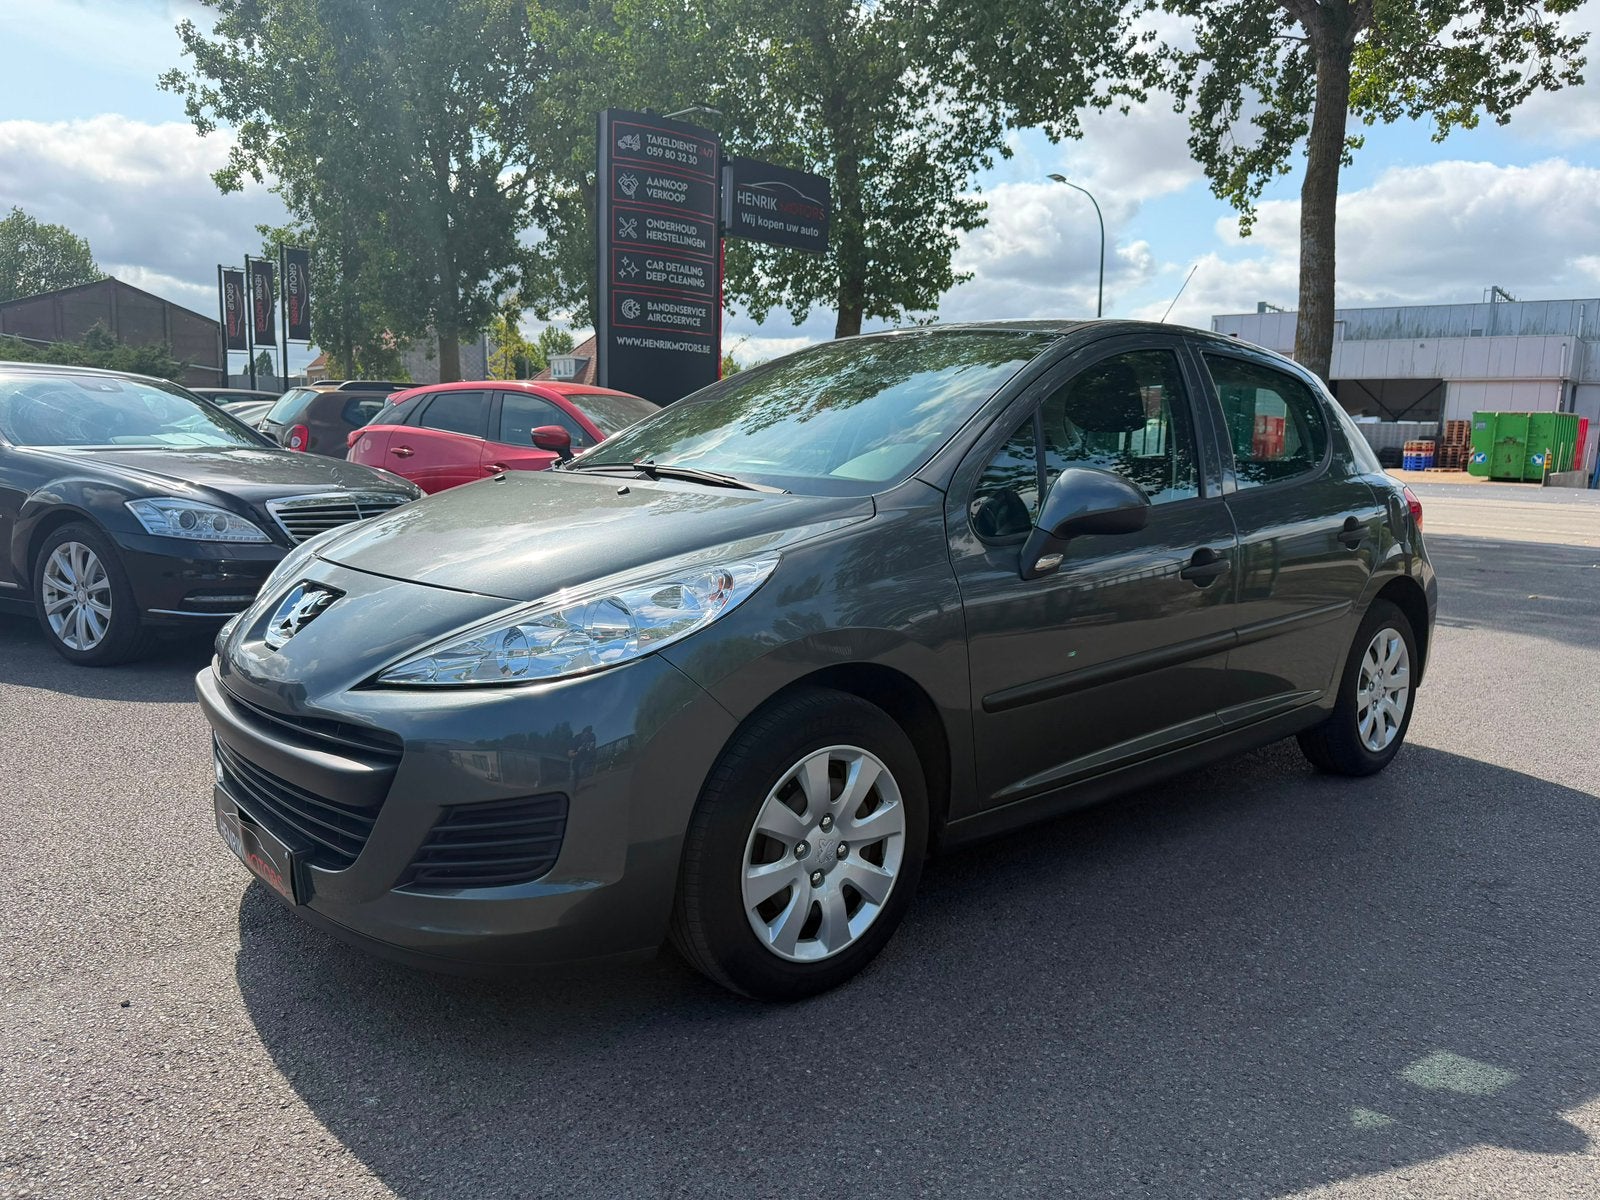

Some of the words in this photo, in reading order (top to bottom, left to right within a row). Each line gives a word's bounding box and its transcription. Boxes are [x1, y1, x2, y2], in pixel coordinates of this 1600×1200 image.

[646, 134, 698, 153] TAKELDIENST
[700, 147, 713, 158] 4/7
[646, 146, 663, 157] 059
[665, 149, 676, 160] 80
[677, 152, 687, 163] 32
[688, 155, 698, 165] 30
[646, 176, 689, 192] AANKOOP
[646, 187, 686, 203] VERKOOP
[737, 190, 777, 211] HENRIK
[646, 219, 698, 235] ONDERHOUD
[741, 212, 756, 227] Wij
[758, 215, 784, 230] kopen
[786, 223, 799, 233] uw
[800, 226, 819, 237] auto
[646, 230, 706, 249] HERSTELLINGEN
[646, 260, 665, 270] CAR
[666, 262, 703, 277] DETAILING
[254, 273, 263, 301] HENRIK
[288, 262, 298, 294] GROUP
[646, 271, 667, 282] DEEP
[668, 274, 705, 288] CLEANING
[226, 282, 235, 311] GROUP
[647, 302, 706, 317] BANDENSERVICE
[647, 313, 701, 327] AIRCOSERVICE
[616, 336, 711, 354] WWW.HENRIKMOTORS.BE
